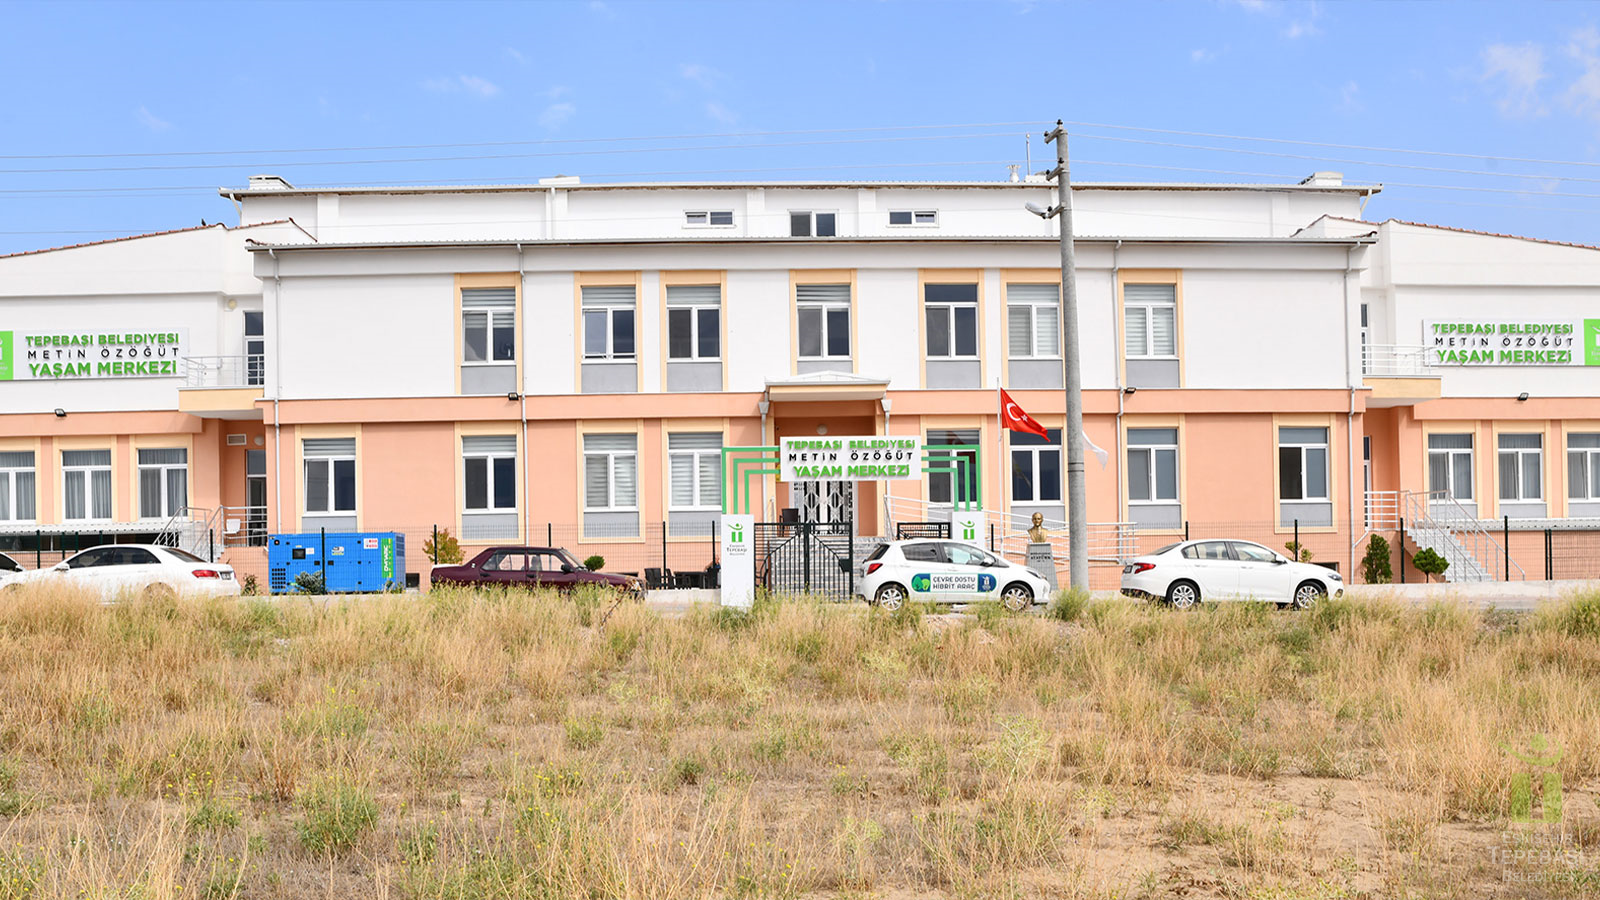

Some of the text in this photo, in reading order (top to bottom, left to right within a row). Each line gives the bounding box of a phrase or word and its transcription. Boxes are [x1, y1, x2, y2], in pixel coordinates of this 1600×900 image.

[1432, 323, 1496, 335] TEPEBAŞI
[25, 334, 94, 347] TEPEBAŞI
[1502, 335, 1574, 347] ÖZÖĞÜT
[27, 344, 179, 360] METİN ÖZÖĞÜT
[1436, 349, 1572, 364] YAŞAM MERKEZİ
[28, 359, 177, 378] YAŞAM MERKEZİ
[788, 449, 913, 461] METİN ÖZÖĞÜT
[793, 464, 910, 479] YAŞAM MERKEZİ
